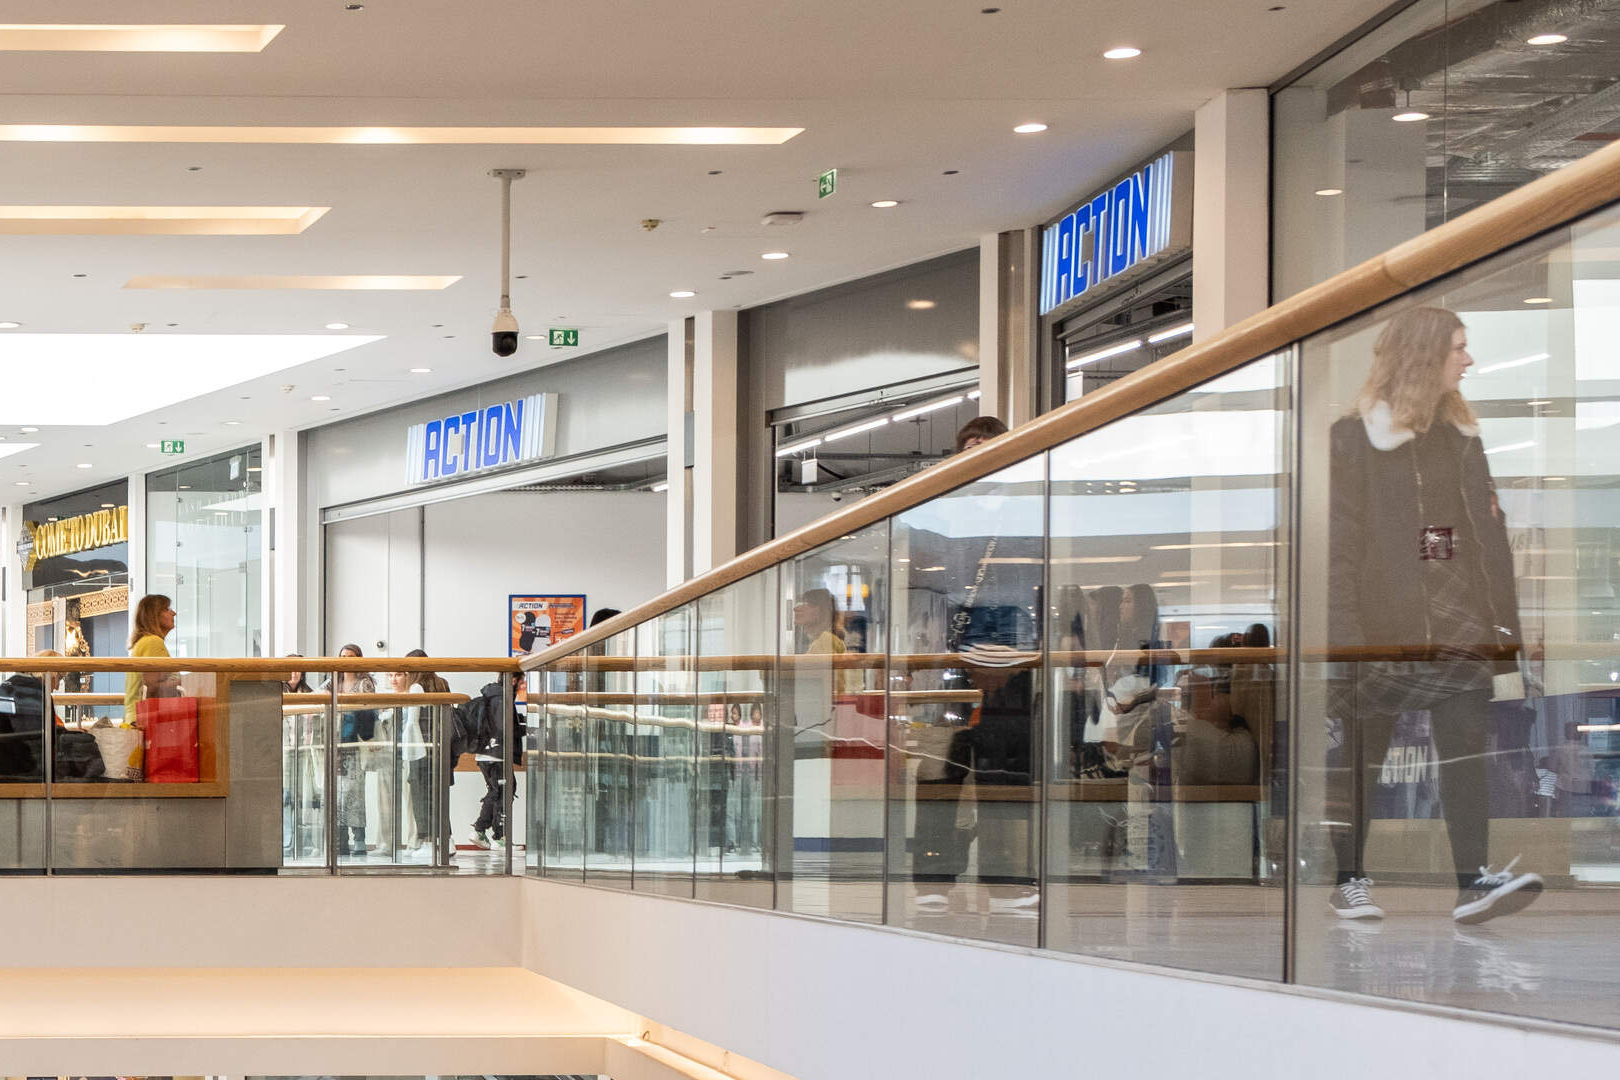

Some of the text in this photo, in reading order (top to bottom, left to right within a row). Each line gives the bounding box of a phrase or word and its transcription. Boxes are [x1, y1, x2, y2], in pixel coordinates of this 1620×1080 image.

[1056, 164, 1154, 304] ACTION
[422, 398, 525, 480] ACTION
[36, 505, 128, 560] COME TO DUBAI
